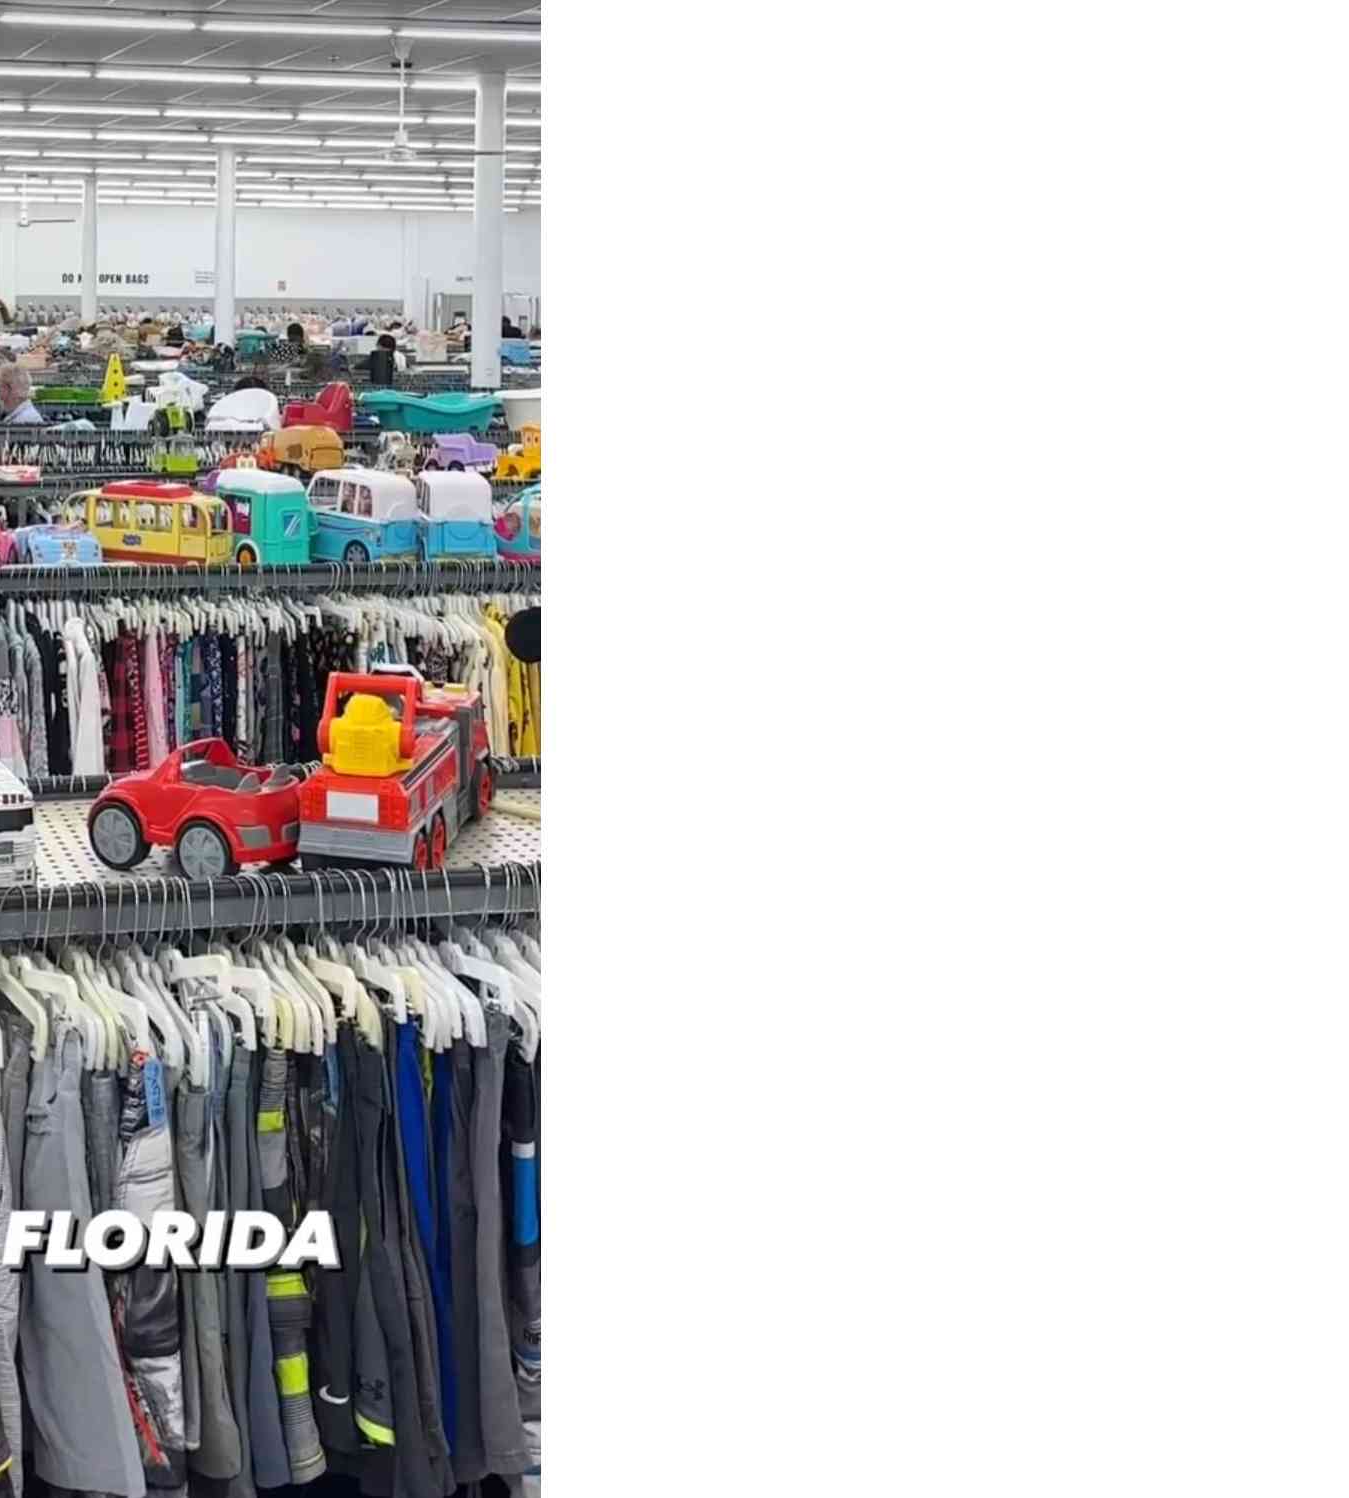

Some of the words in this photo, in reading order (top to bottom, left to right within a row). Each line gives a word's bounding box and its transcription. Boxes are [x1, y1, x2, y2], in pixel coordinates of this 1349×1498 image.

[61, 272, 74, 284] DO
[99, 273, 122, 285] OPEN
[125, 273, 149, 285] BAGS
